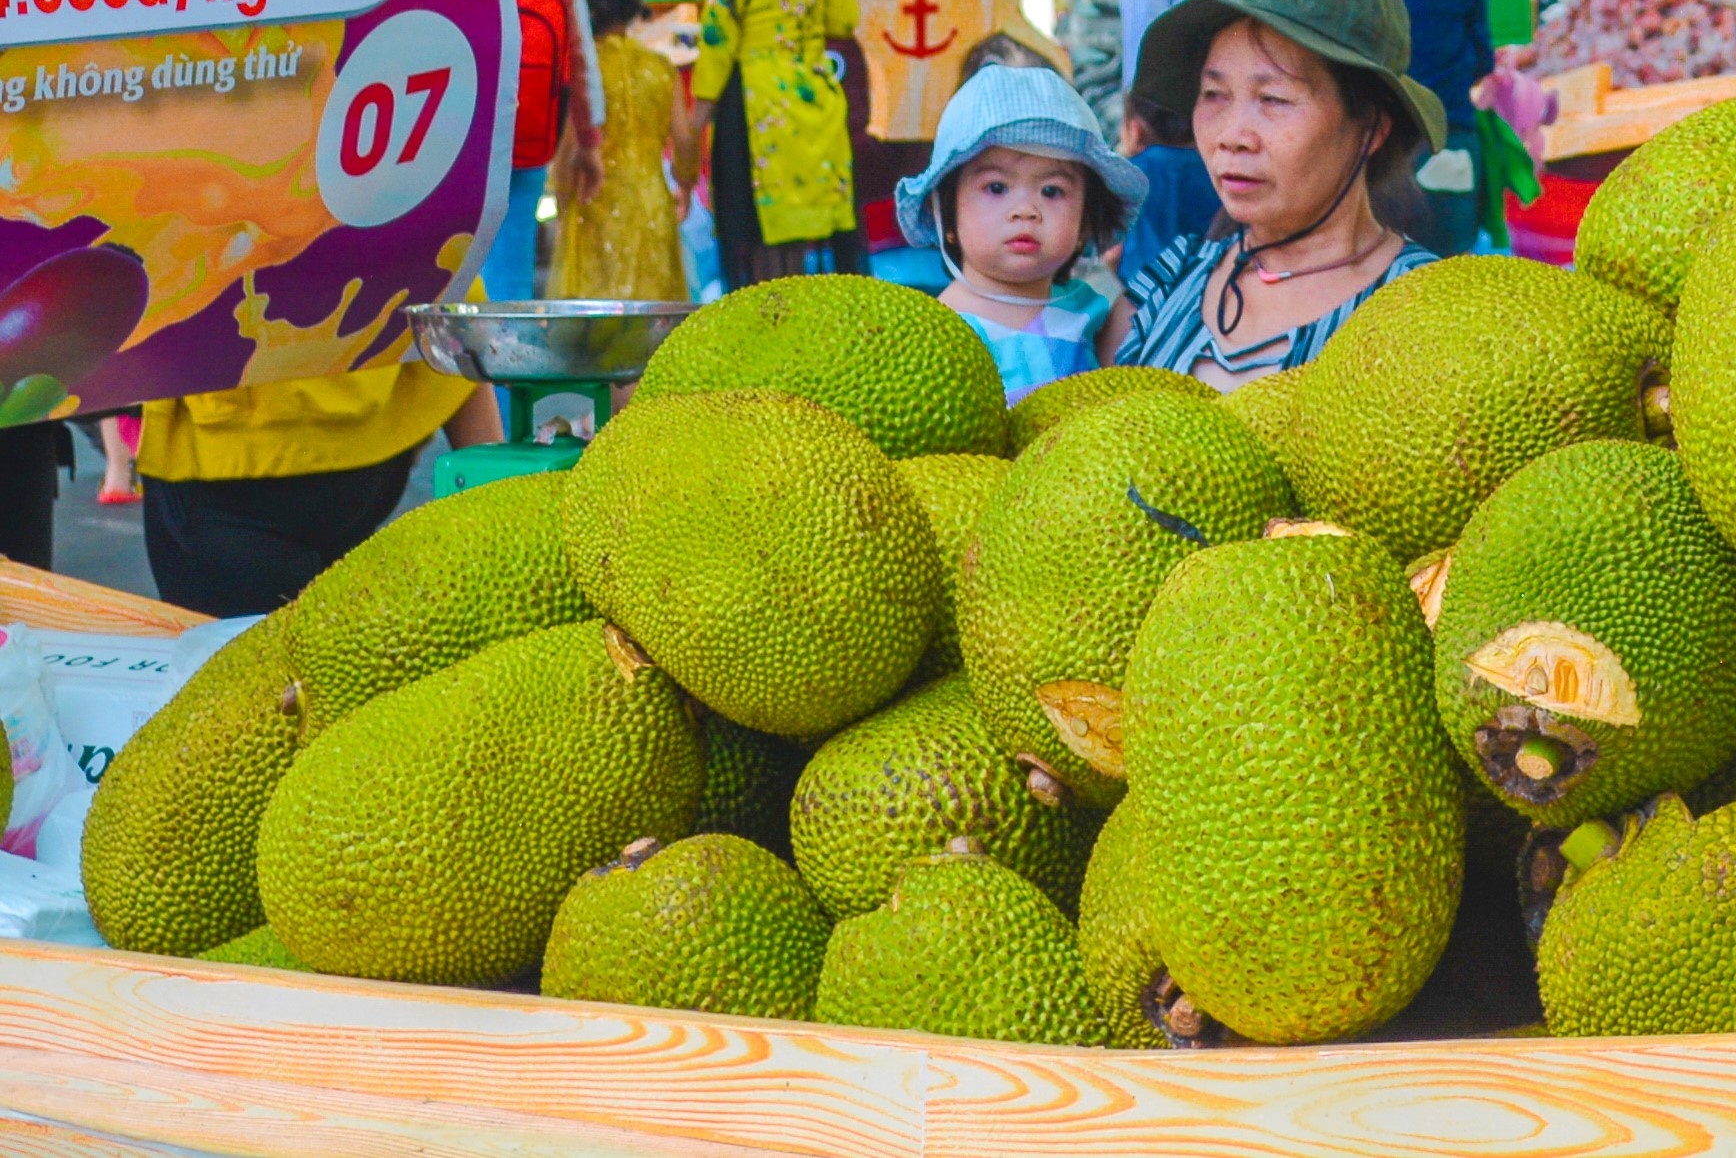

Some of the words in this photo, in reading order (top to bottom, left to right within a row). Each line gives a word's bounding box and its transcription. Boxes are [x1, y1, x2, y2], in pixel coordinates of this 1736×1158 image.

[33, 60, 145, 103] không
[150, 51, 237, 94] dùng
[338, 65, 453, 178] 07
